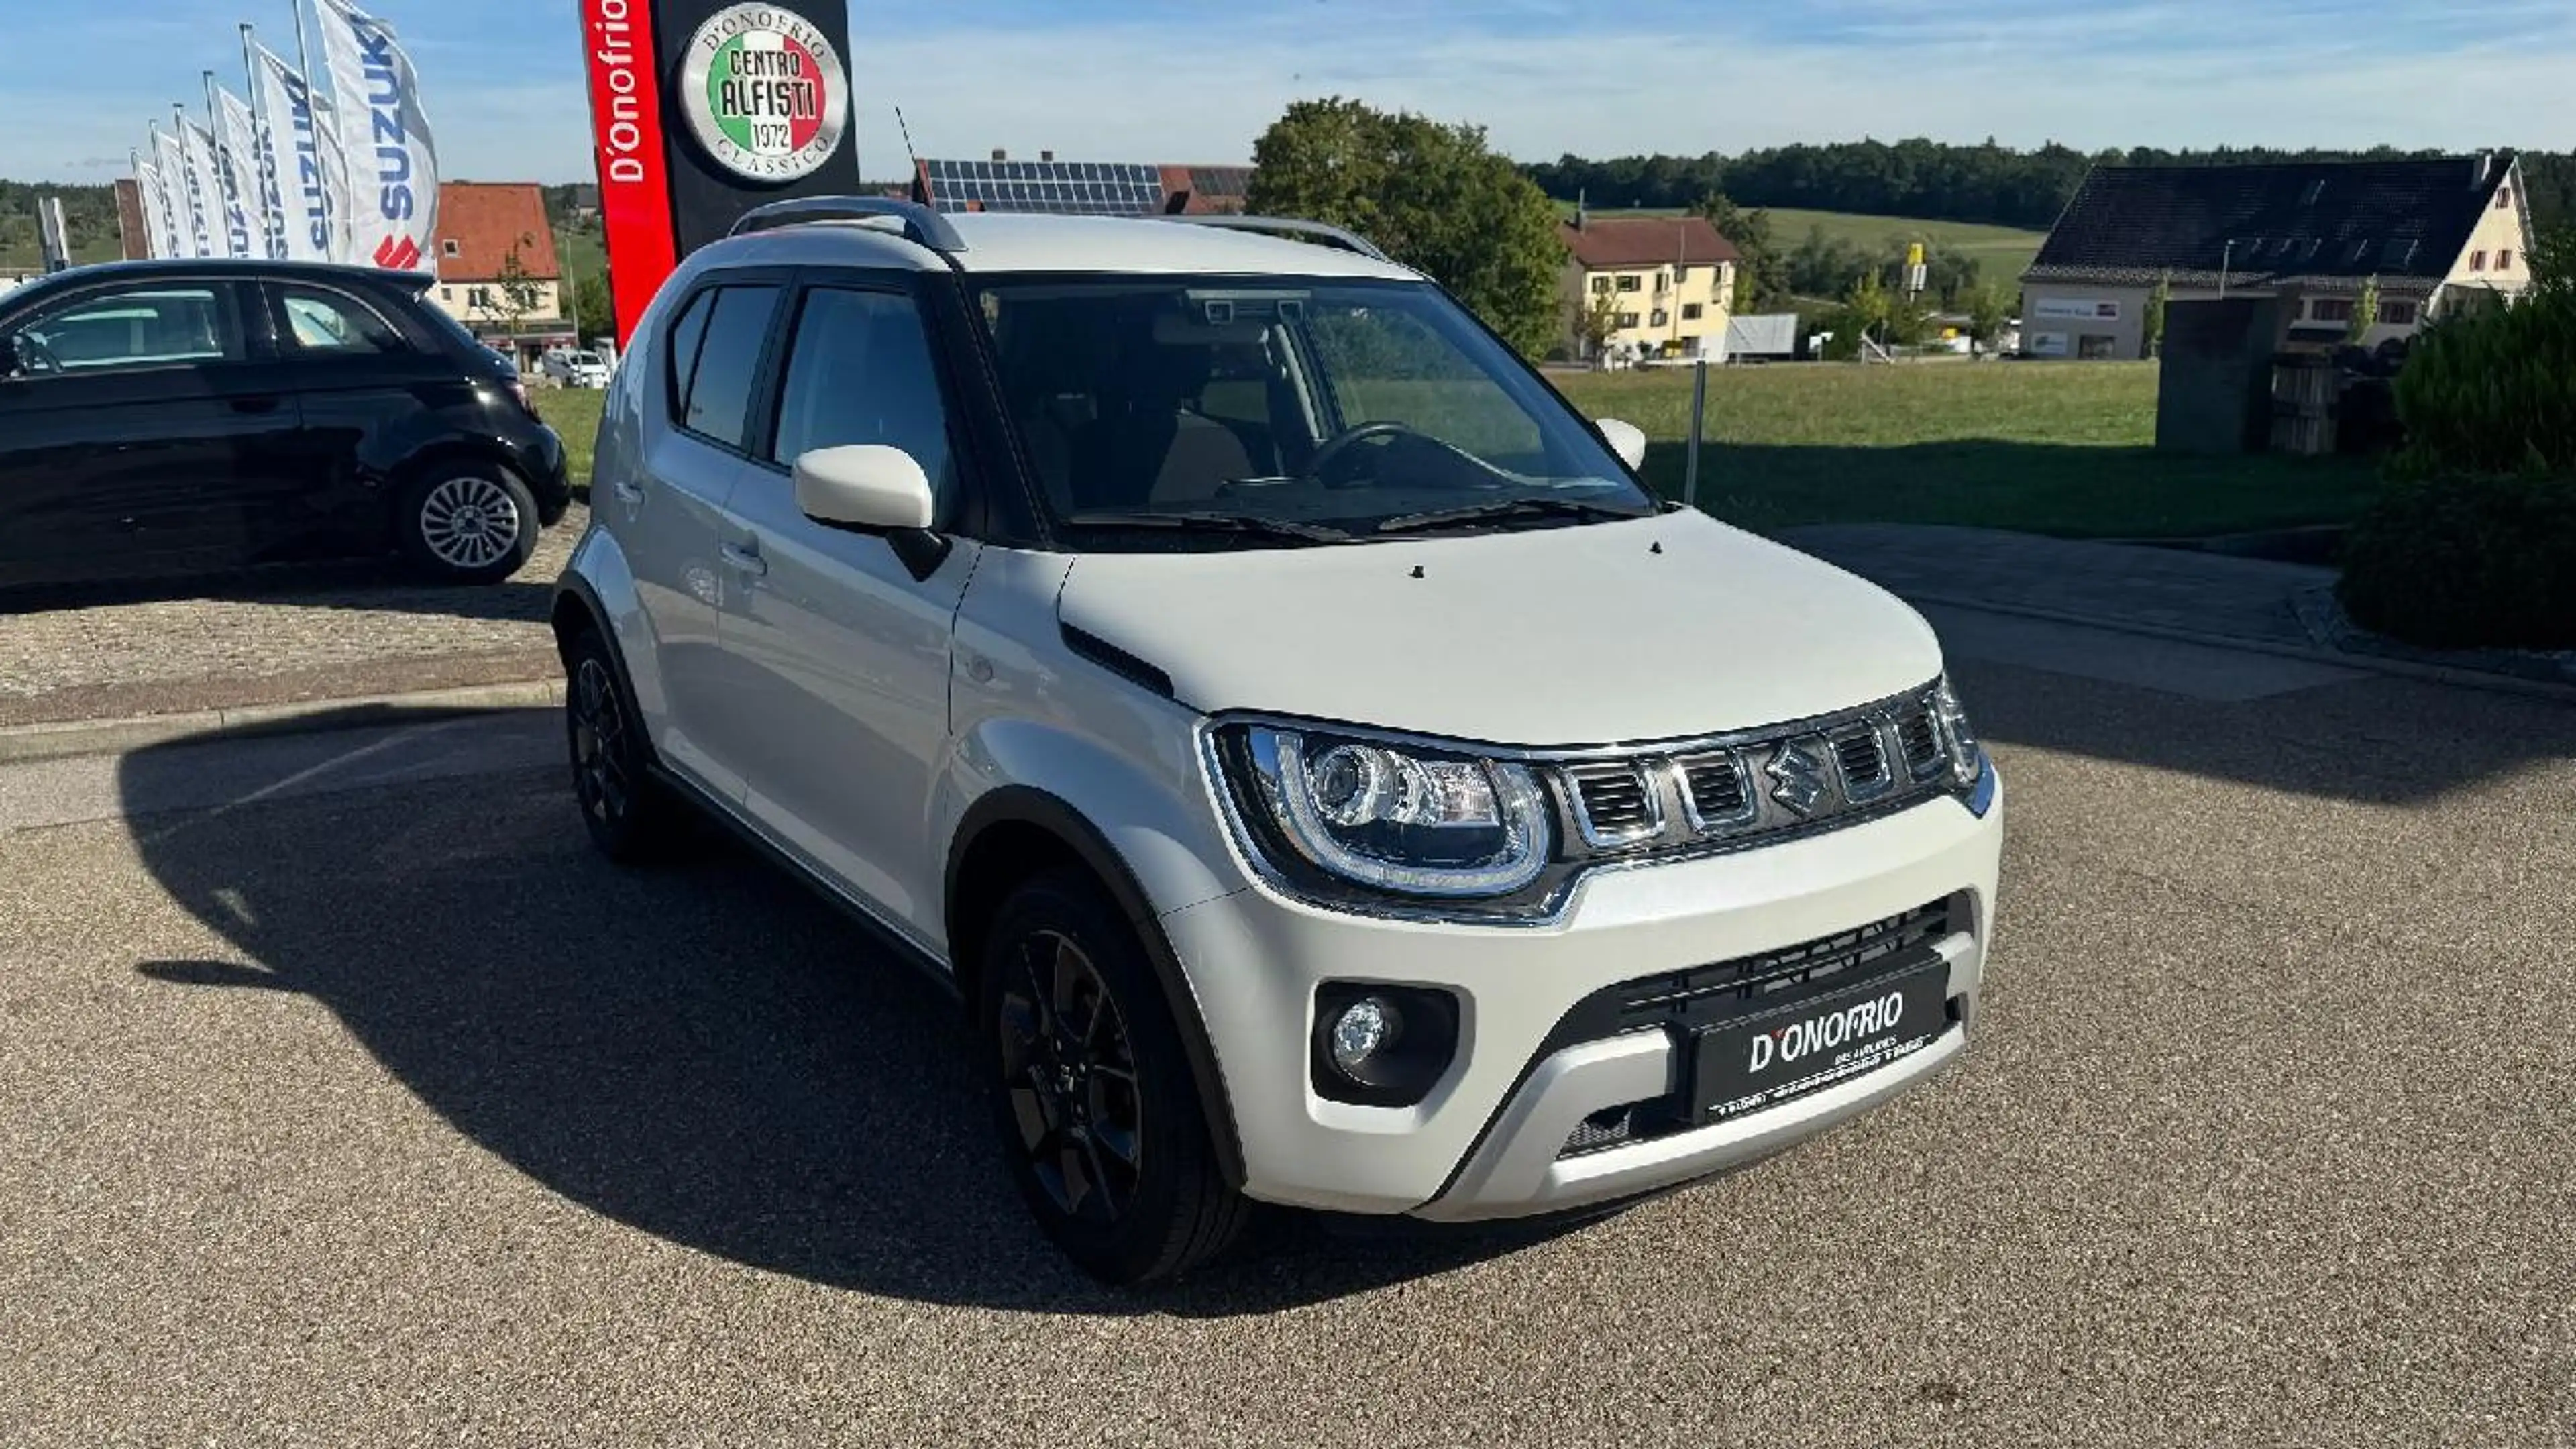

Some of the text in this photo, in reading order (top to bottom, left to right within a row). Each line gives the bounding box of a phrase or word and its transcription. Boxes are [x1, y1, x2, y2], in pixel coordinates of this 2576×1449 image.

[704, 11, 824, 58] D'ONOFRIO
[731, 50, 800, 77] CENTRO
[721, 80, 815, 116] ALFISTI
[718, 136, 828, 173] CLASSICO
[753, 125, 789, 148] 1972
[1749, 991, 1903, 1073] D'ONOFRIO
